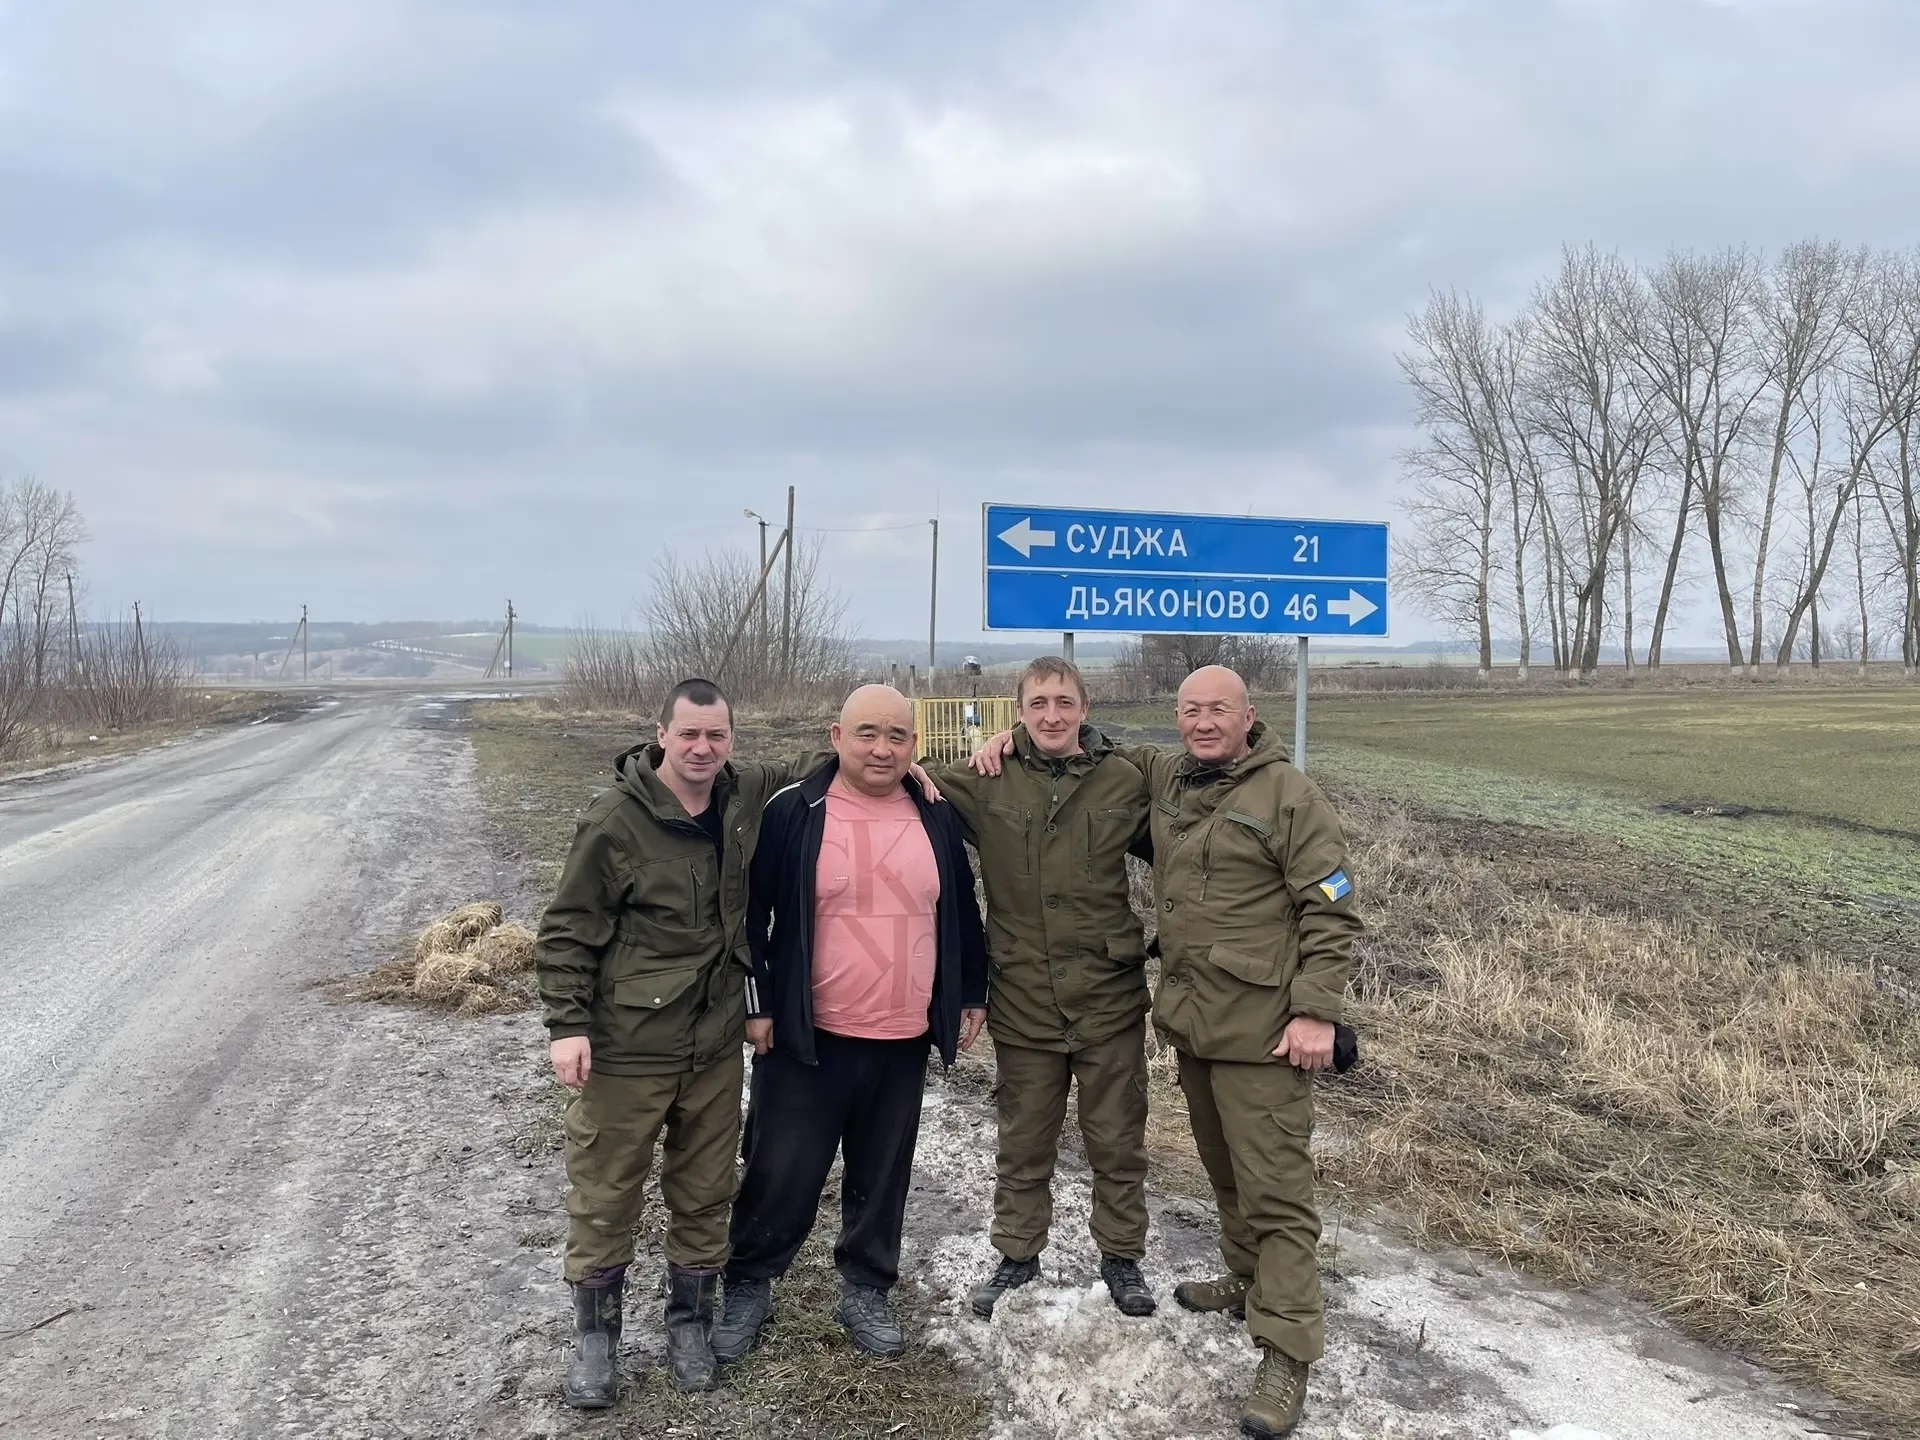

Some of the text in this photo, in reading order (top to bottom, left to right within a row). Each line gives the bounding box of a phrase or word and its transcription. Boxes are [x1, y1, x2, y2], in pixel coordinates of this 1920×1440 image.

[1066, 524, 1319, 563] СУДЖА 21
[1065, 586, 1318, 621] ДЬЯКОНОВО 46
